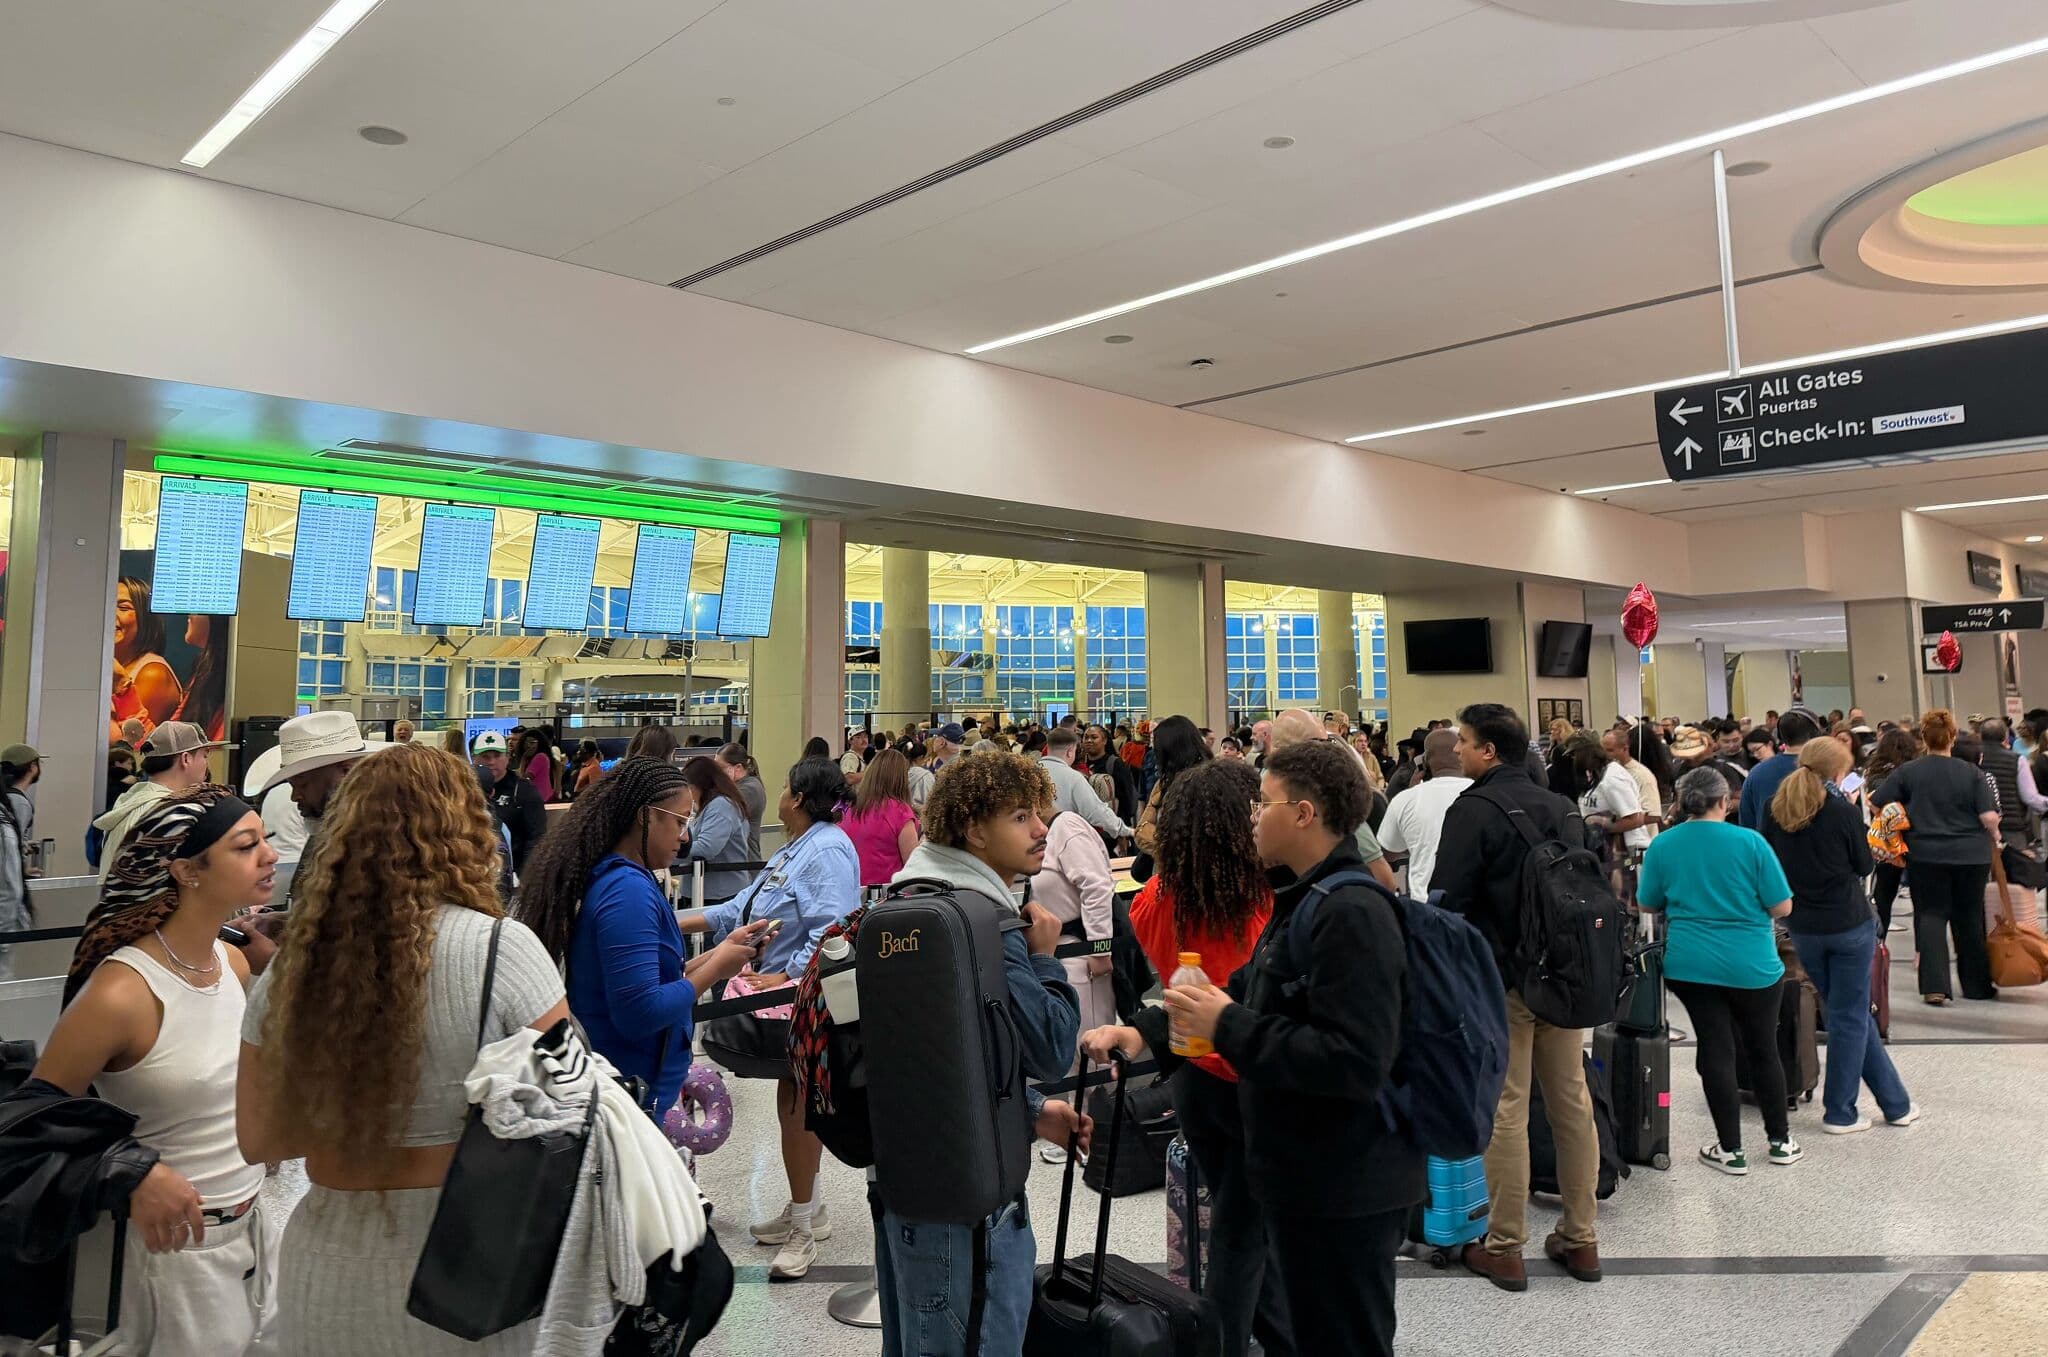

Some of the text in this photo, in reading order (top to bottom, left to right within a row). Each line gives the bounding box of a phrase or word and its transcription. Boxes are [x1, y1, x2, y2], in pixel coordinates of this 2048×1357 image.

[1759, 369, 1864, 398] All Gates
[1759, 398, 1818, 416] Puertas
[1880, 411, 1950, 430] Southwest
[1759, 419, 1866, 448] Check-In:
[164, 480, 197, 490] ARRIVALS
[303, 493, 332, 503] ARRIVALS
[878, 928, 921, 959] Bach
